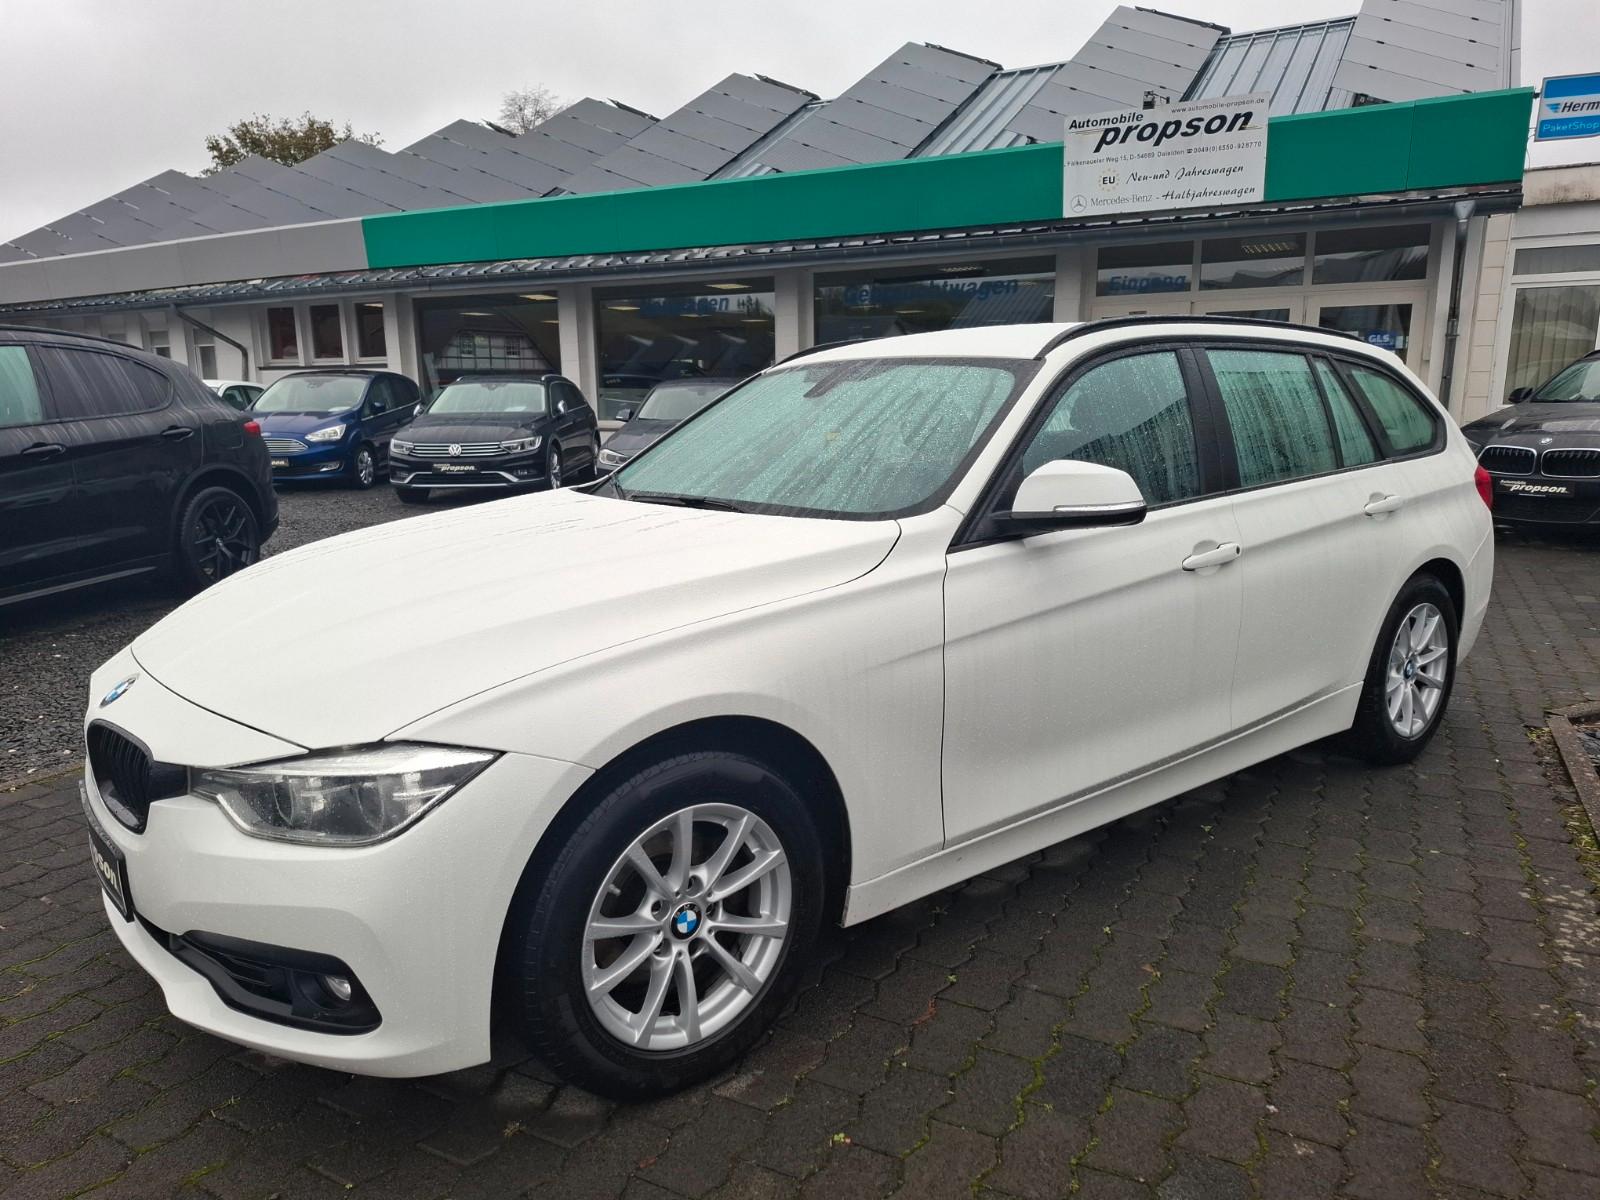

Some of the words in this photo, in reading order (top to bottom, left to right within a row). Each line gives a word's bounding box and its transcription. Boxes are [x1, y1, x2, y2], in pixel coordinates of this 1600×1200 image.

[1171, 98, 1265, 114] www.automobile-propson.de
[1068, 112, 1144, 130] Automobile
[1093, 111, 1254, 153] propson
[1174, 164, 1244, 180] Jahreswagen
[1102, 176, 1116, 185] EU
[1090, 194, 1153, 207] Mercedes-Benz
[1109, 274, 1187, 292] Eingng
[1368, 334, 1390, 343] GLS
[1509, 484, 1567, 493] propson
